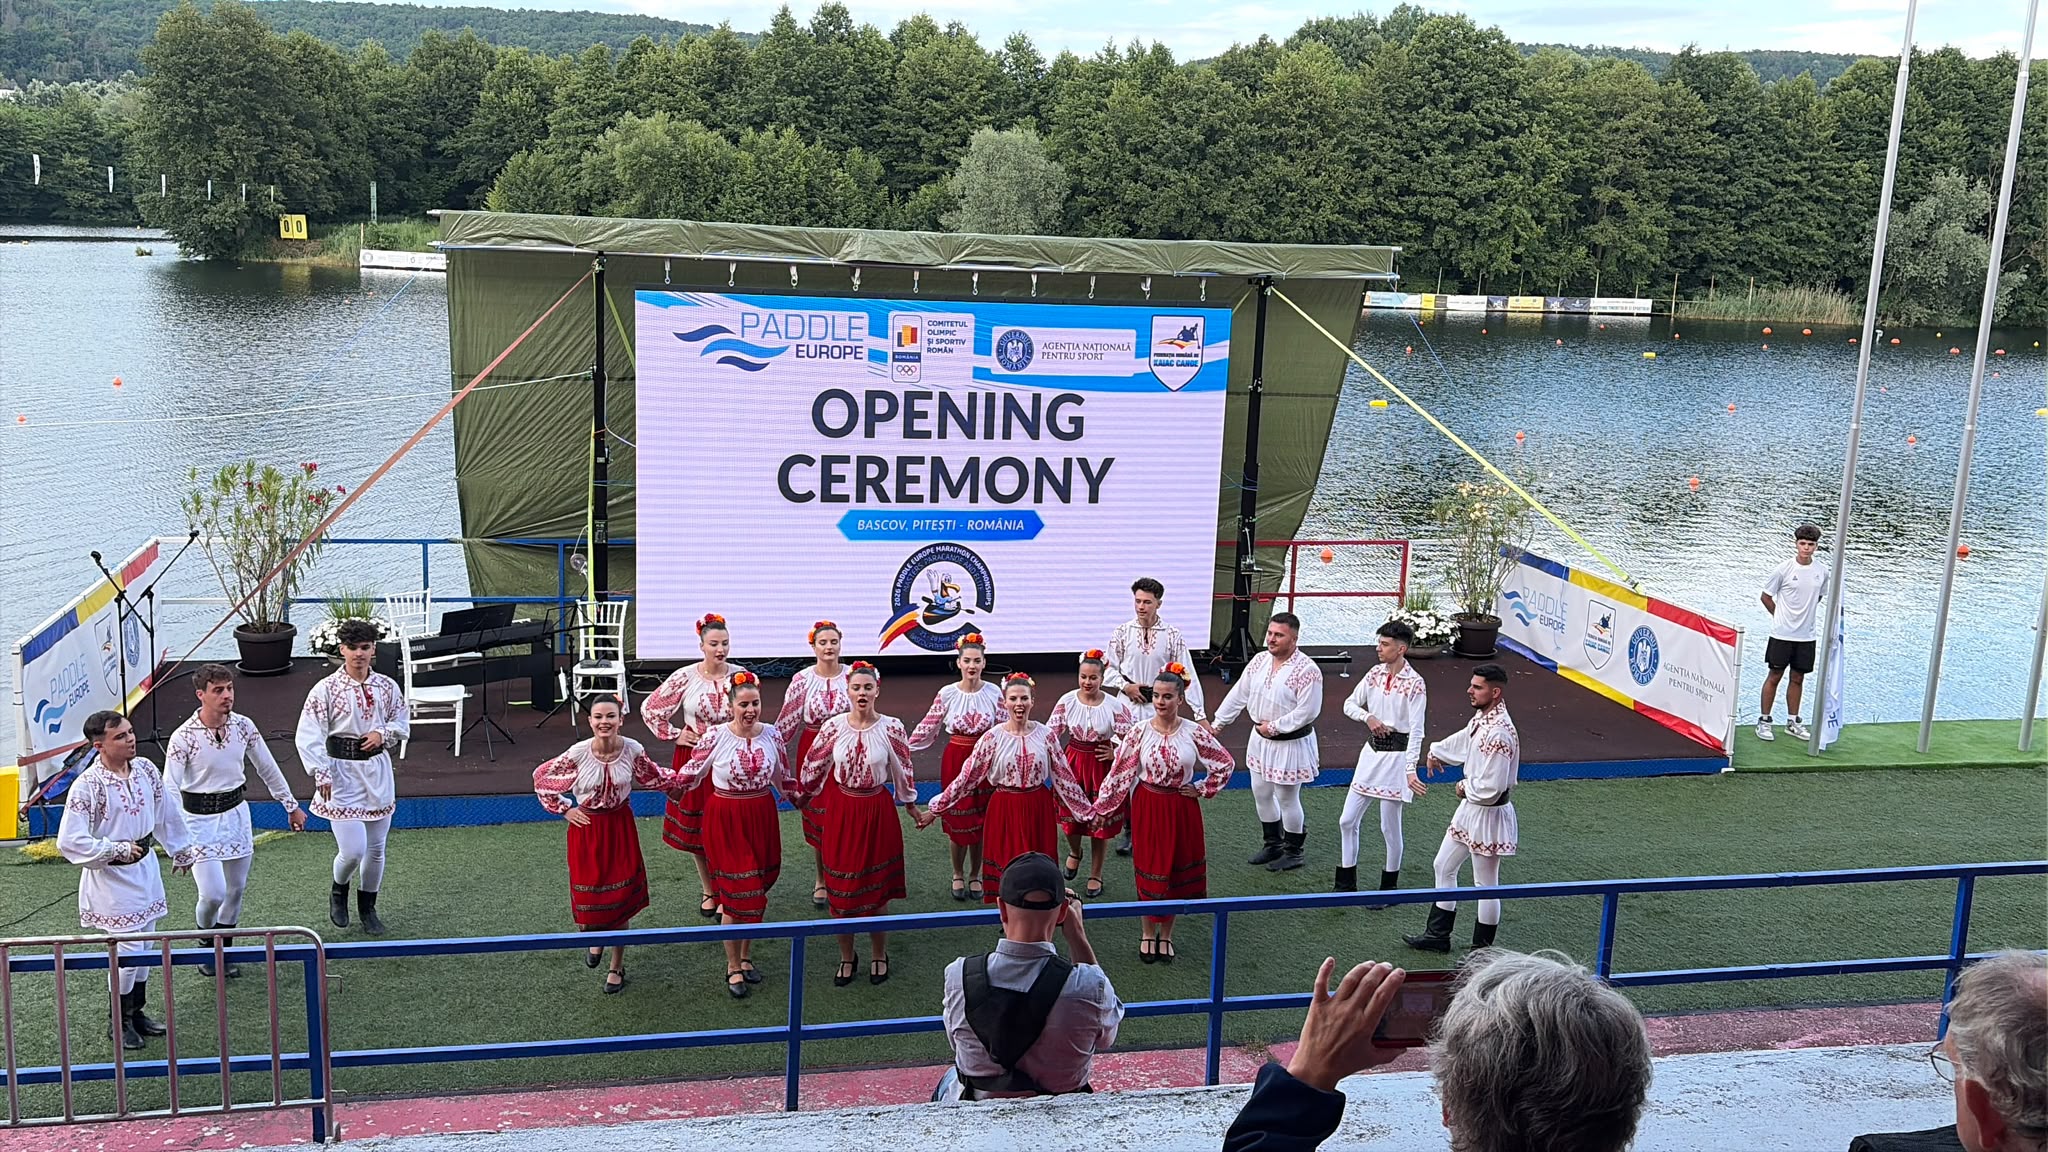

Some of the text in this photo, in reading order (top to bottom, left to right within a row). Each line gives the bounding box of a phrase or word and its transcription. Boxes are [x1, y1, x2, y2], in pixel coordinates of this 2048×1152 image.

[741, 312, 865, 342] PADDLE
[927, 320, 968, 328] COMITETUL
[795, 344, 864, 360] EUROPE
[926, 346, 954, 354] ROMÂN
[935, 338, 967, 346] SPORTIV
[1041, 351, 1105, 361] PENTRU SPORT
[1153, 359, 1199, 367] KAIAC CANOE
[811, 388, 1085, 441] OPENING
[777, 454, 1116, 504] CEREMONY
[857, 519, 909, 532] BASCOV,
[912, 519, 956, 533] PITEȘTI
[967, 517, 1025, 531] ROMÂNIA
[896, 563, 913, 588] PADDLE
[911, 547, 935, 565] EUROPE
[935, 545, 971, 559] MARATHON
[970, 556, 992, 606] CHAMPIONSHIPS
[1523, 586, 1568, 622] PADDLE
[1539, 614, 1566, 635] EUROPE
[1632, 628, 1658, 654] GUVERNUL
[50, 653, 87, 702] PADDLE
[1668, 677, 1713, 703] PENTRU SPORT
[68, 680, 90, 708] EUROPE
